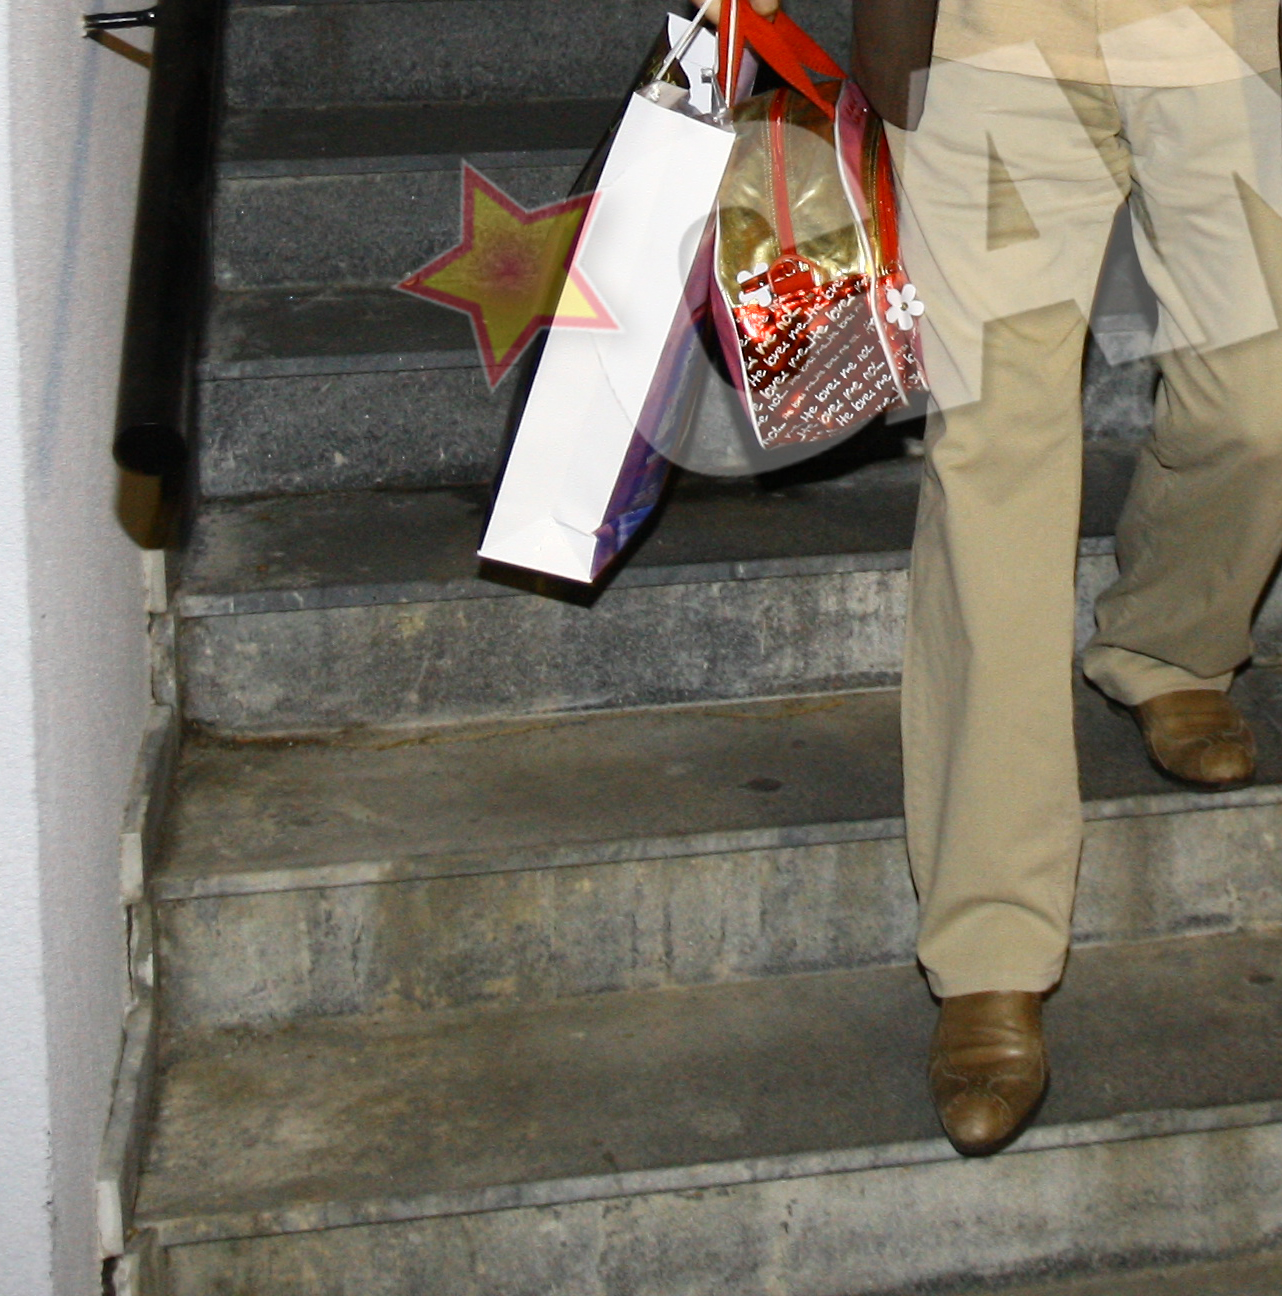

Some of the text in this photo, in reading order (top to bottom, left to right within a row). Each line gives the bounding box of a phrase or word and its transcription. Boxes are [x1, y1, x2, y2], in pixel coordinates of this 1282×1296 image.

[746, 369, 767, 387] He
[799, 405, 818, 423] He
[839, 361, 857, 379] me
[835, 411, 854, 427] He
